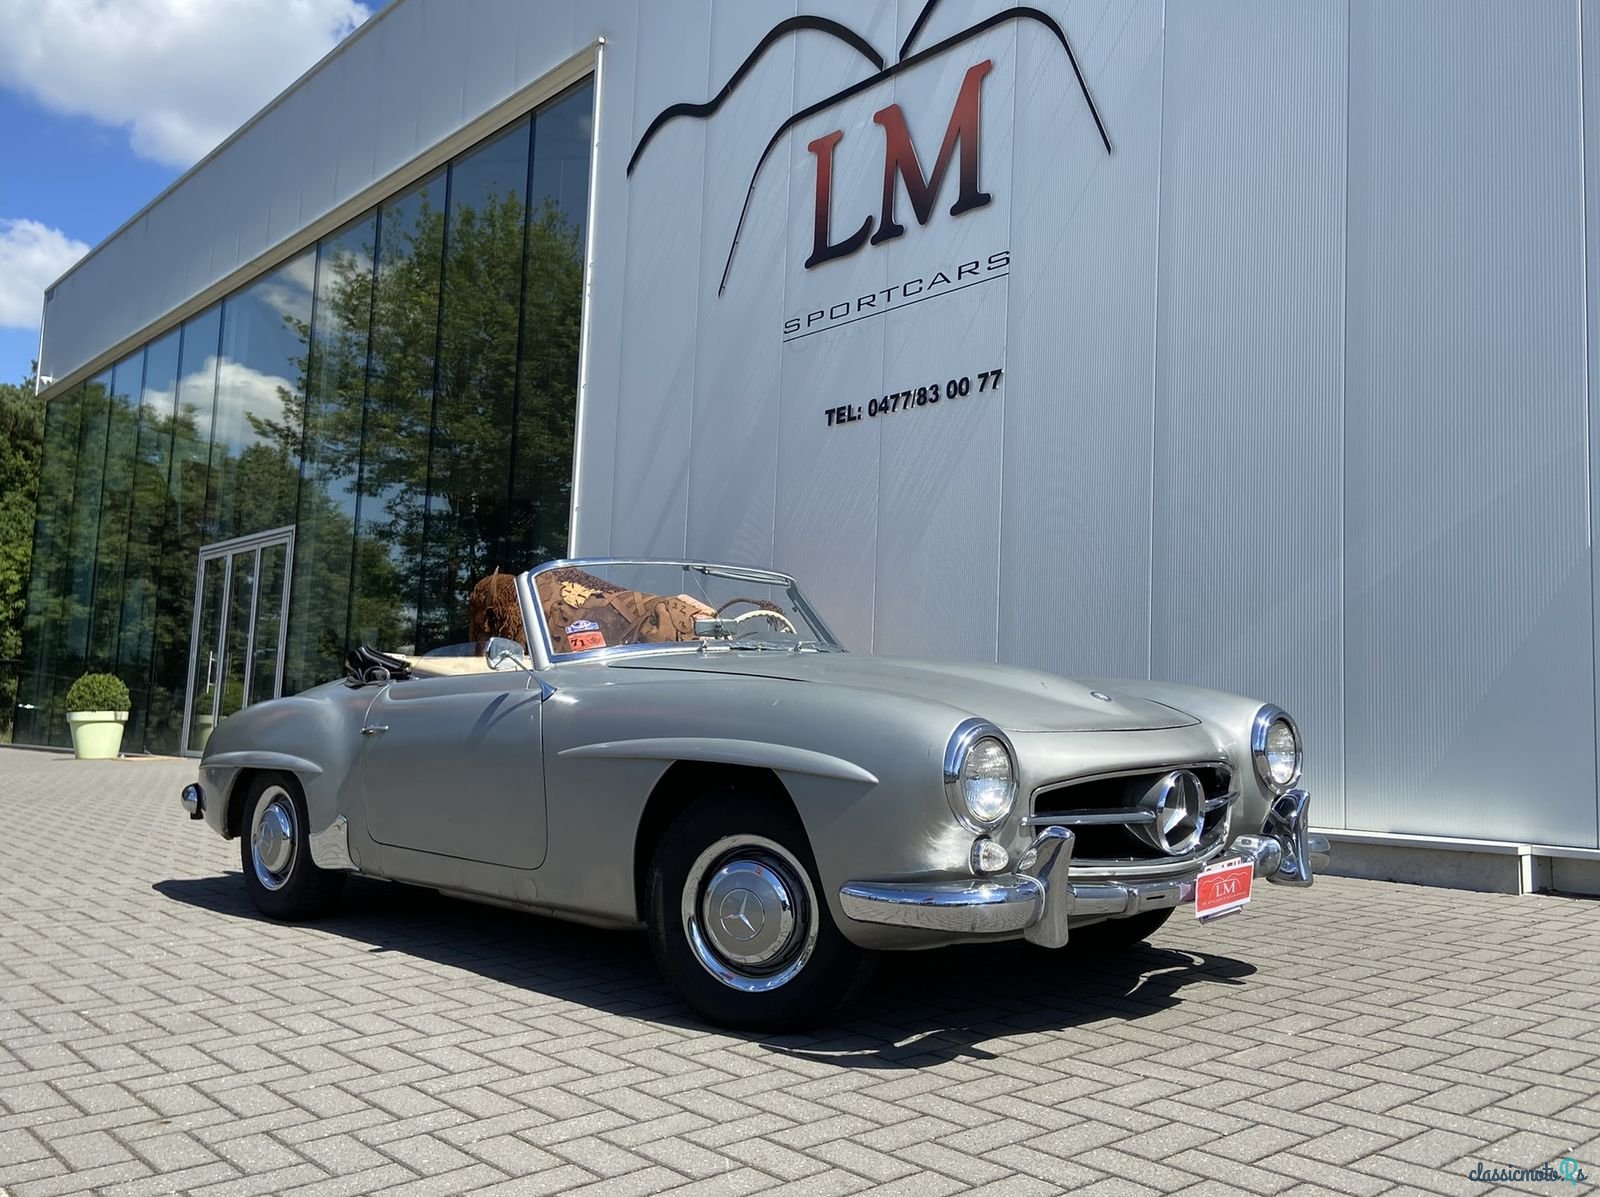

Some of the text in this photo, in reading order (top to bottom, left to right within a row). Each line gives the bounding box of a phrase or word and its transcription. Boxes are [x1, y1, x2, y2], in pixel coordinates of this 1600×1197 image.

[805, 59, 993, 269] LM
[784, 251, 1010, 334] SPORTCARS
[825, 369, 1003, 426] TEL: 0477/83 00 77
[1216, 881, 1236, 898] LM
